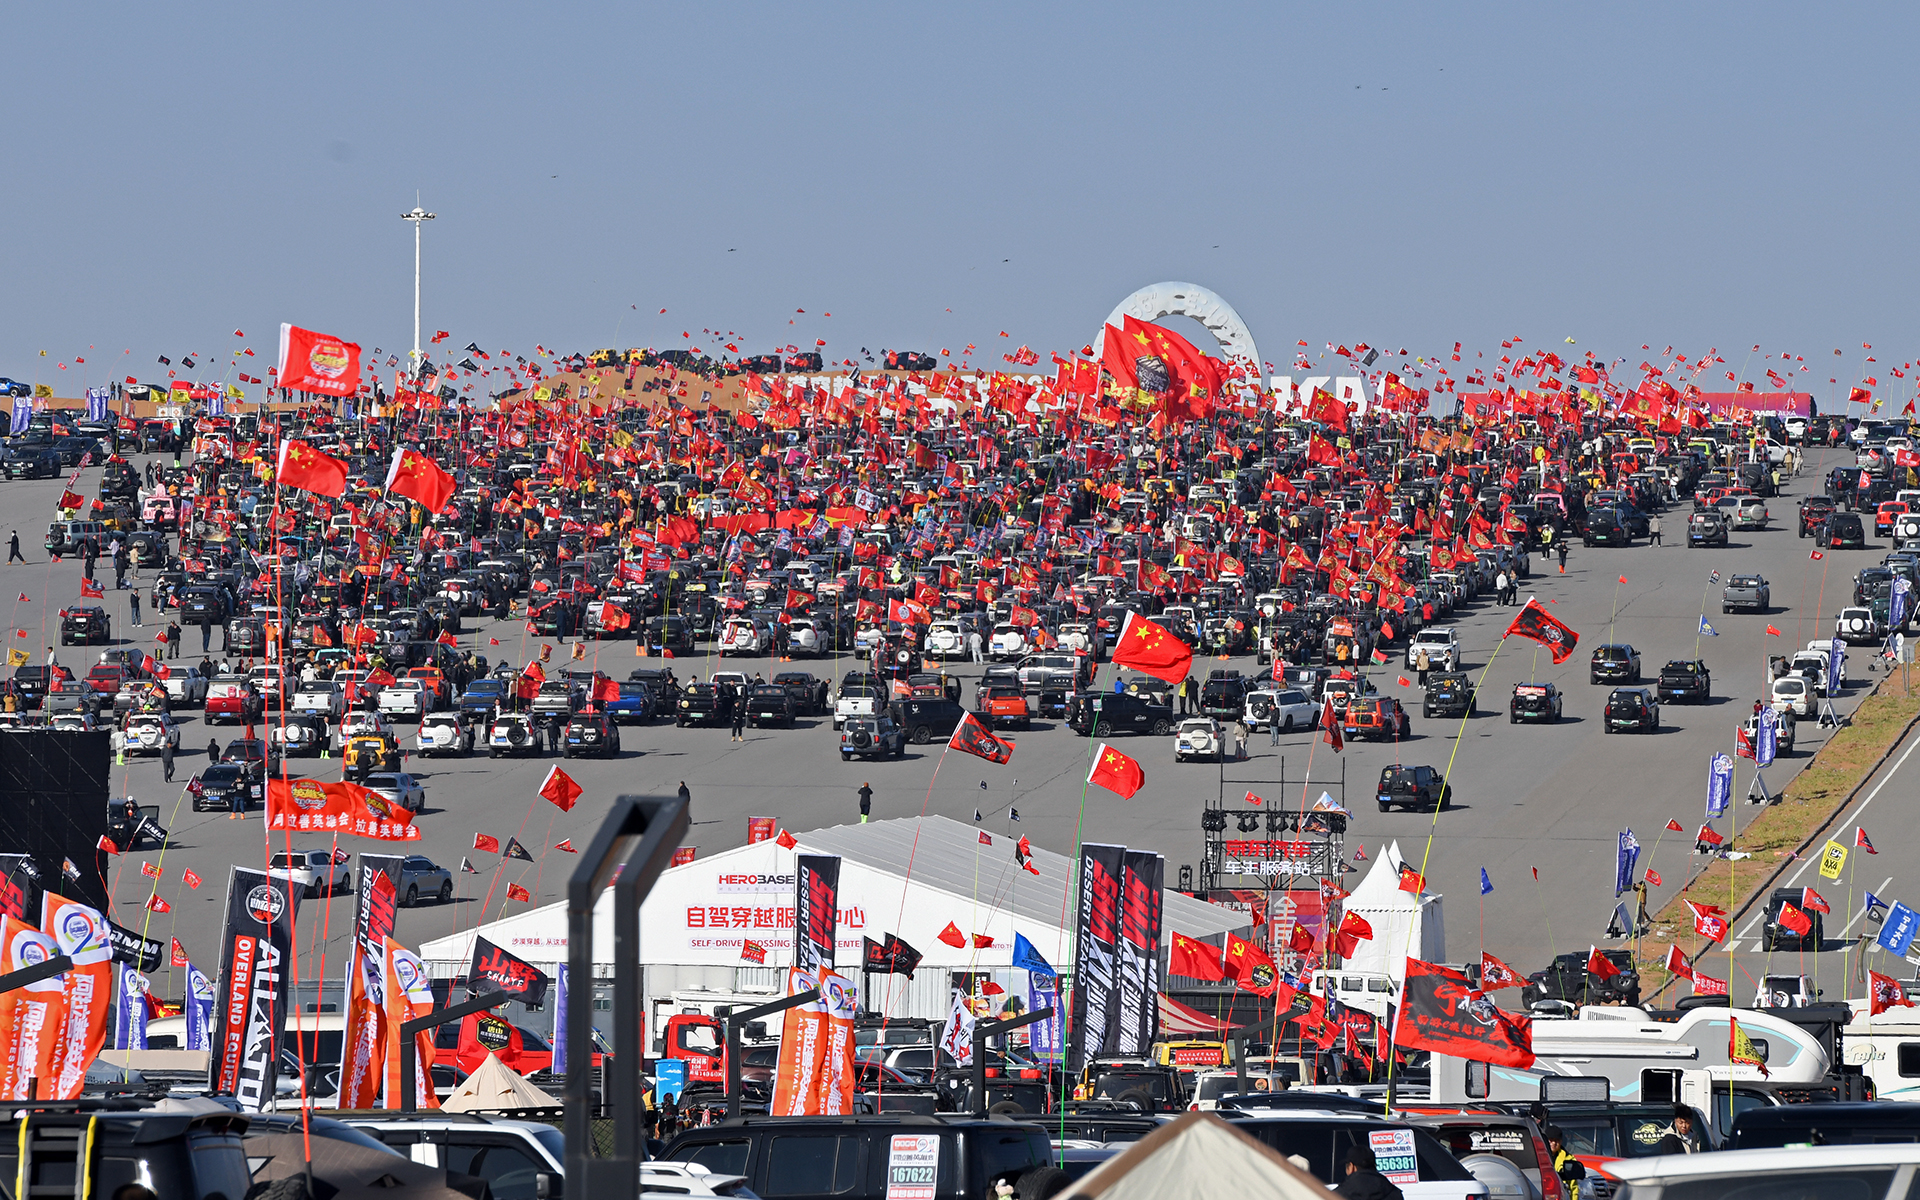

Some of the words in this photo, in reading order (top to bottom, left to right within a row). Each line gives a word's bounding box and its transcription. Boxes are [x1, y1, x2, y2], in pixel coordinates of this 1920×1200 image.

[273, 812, 349, 829] 阿拉善英雄会
[350, 818, 417, 838] 拉善英雄会
[1225, 839, 1311, 858] 京东汽车
[719, 875, 795, 884] HEROBASE
[361, 864, 372, 934] DESERT
[801, 865, 810, 932] DESERT
[1084, 855, 1094, 924] DESERT
[692, 939, 742, 947] SELF-DRIVE
[1078, 926, 1090, 987] LIZARD
[228, 938, 252, 1026] OVERLAND
[486, 970, 524, 987] SHANYE
[1375, 1156, 1415, 1171] 556381
[892, 1167, 933, 1183] 167622
